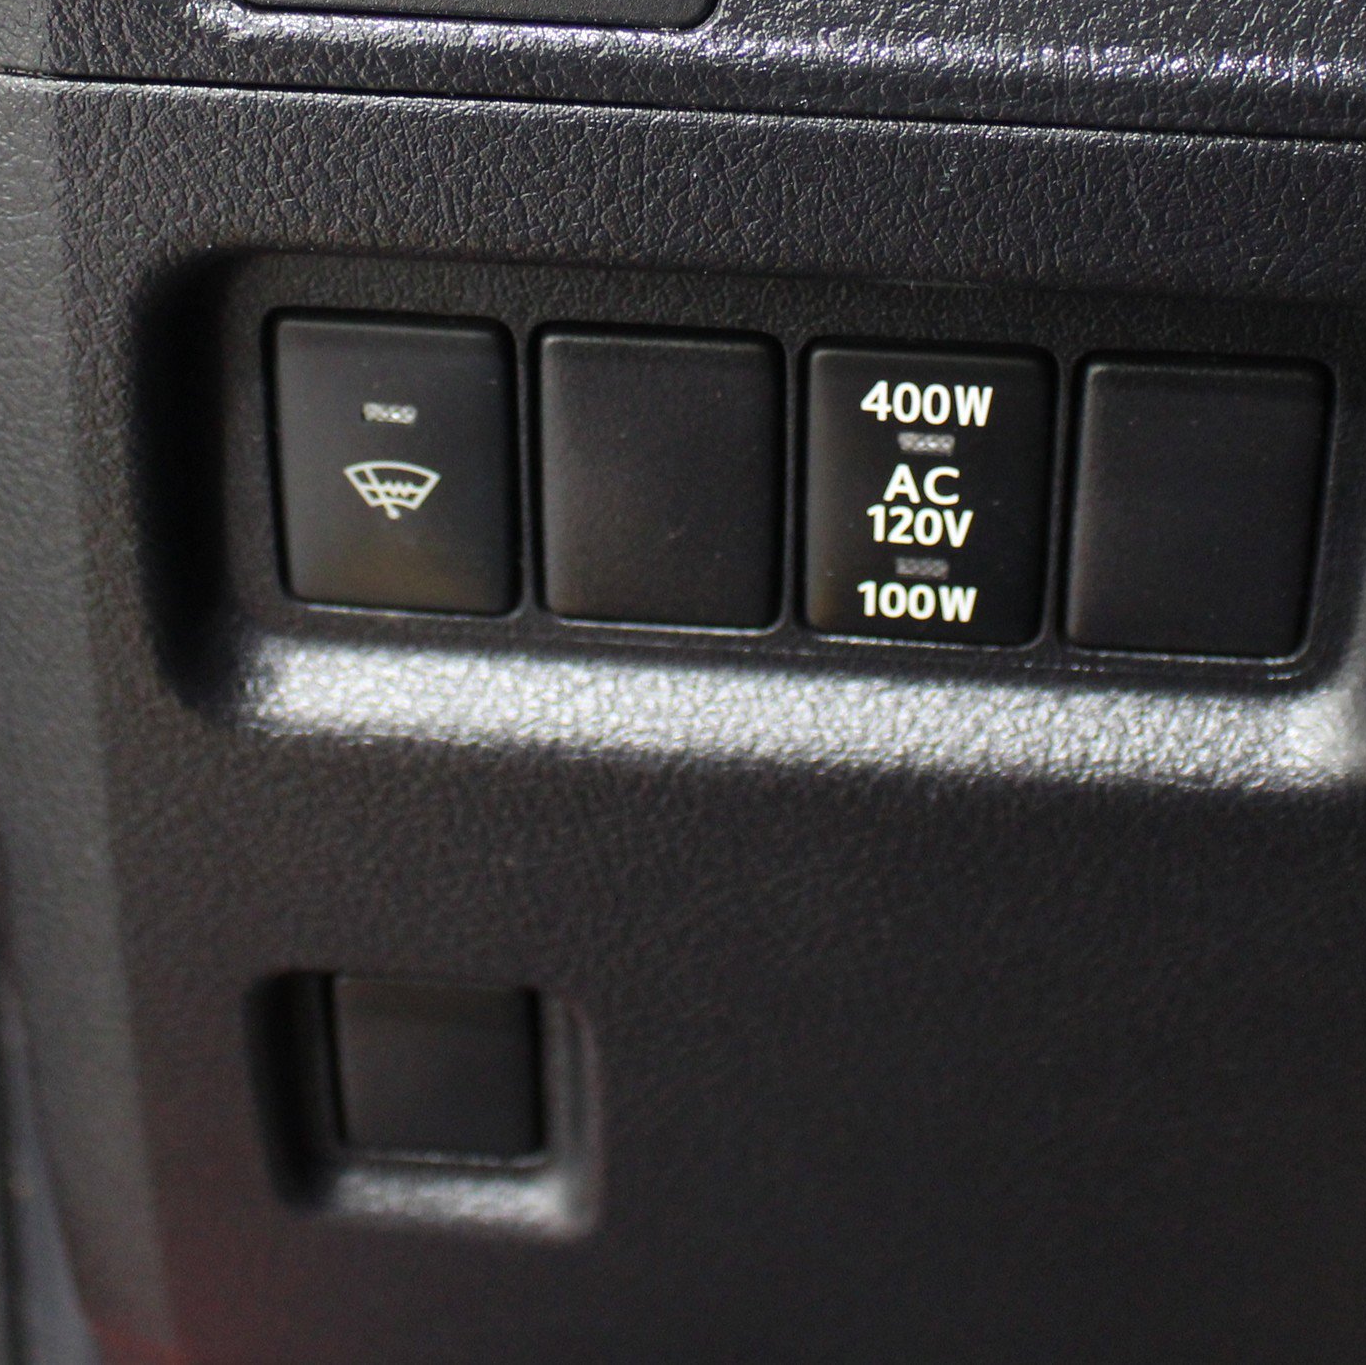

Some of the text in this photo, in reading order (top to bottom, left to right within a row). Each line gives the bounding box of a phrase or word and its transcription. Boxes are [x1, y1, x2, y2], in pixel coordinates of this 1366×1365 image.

[860, 380, 994, 428] 400W
[882, 463, 961, 506] AC
[866, 504, 975, 548] 120V
[857, 580, 978, 623] 100W
